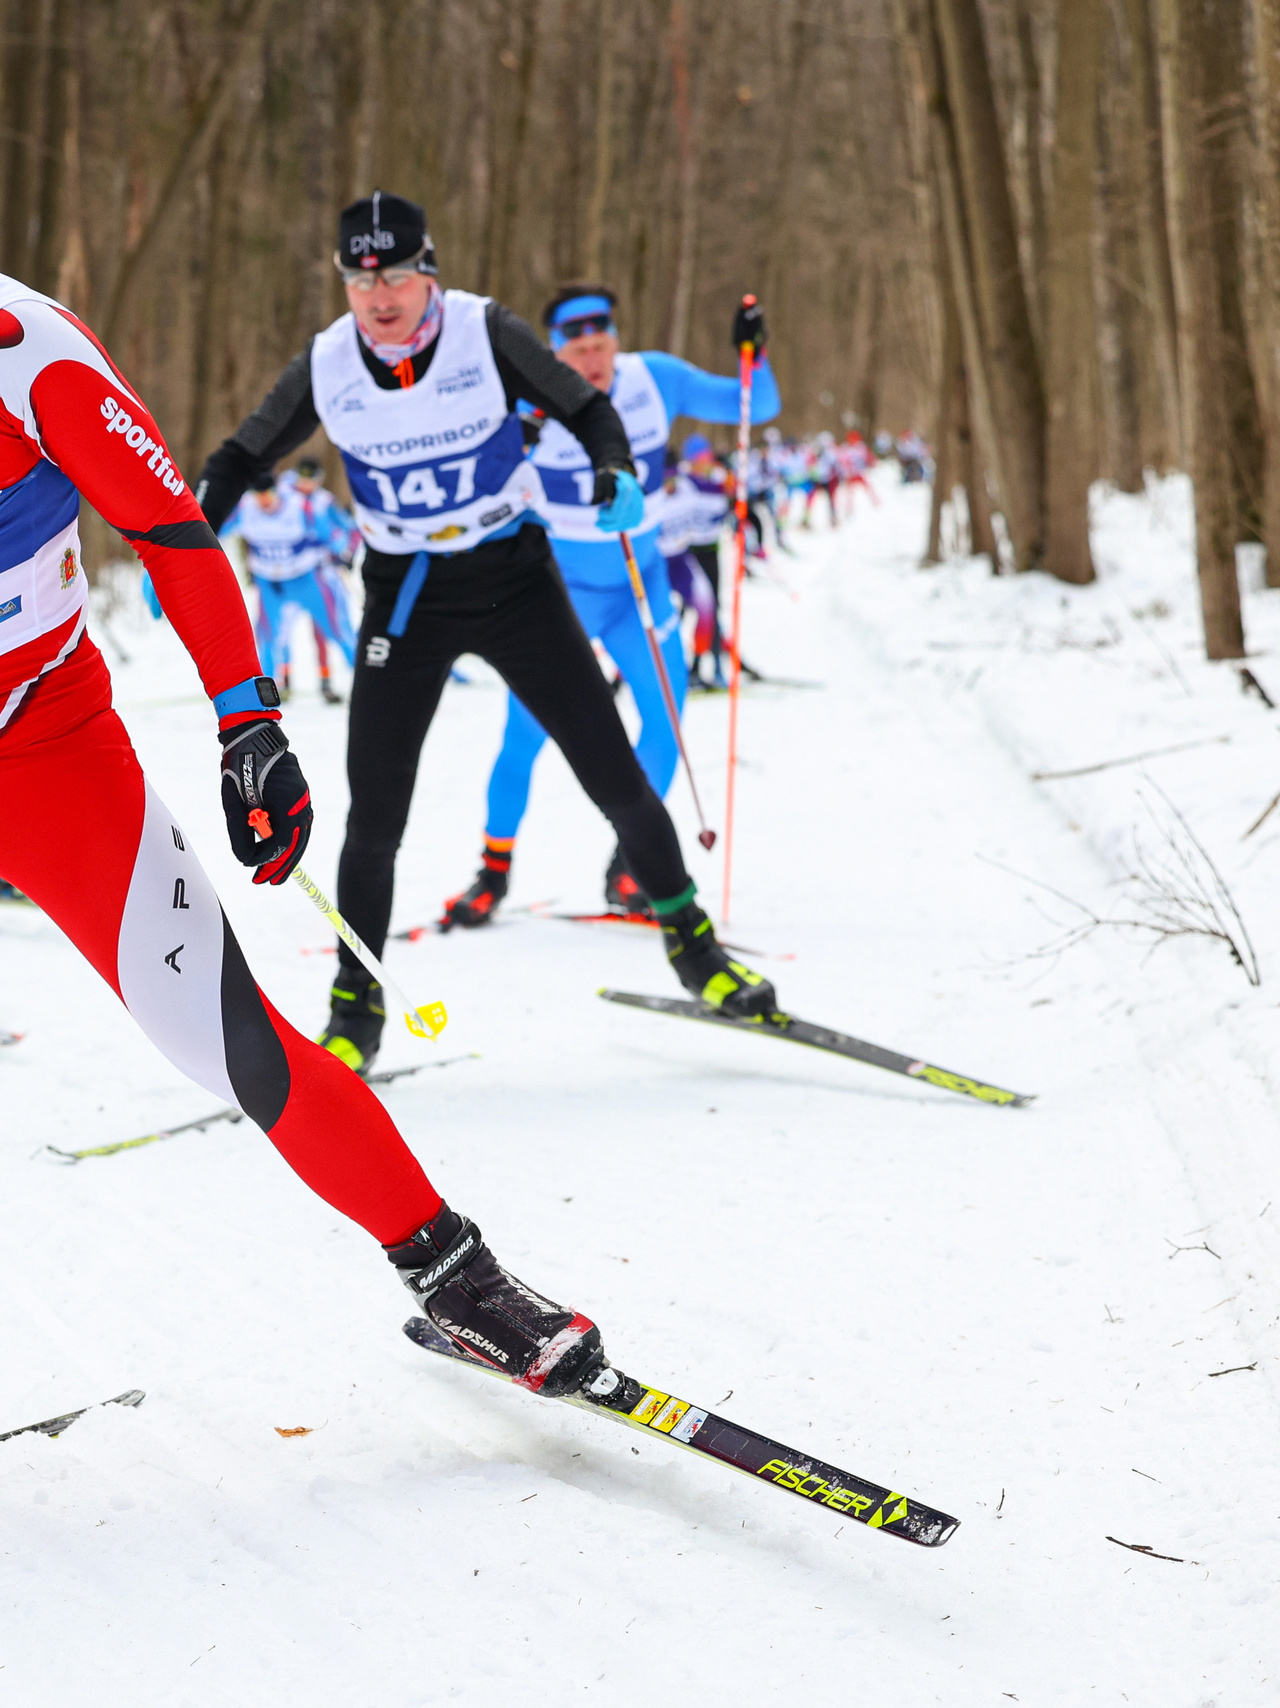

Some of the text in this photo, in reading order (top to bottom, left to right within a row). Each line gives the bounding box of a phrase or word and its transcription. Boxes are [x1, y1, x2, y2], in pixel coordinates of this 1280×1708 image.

[100, 396, 185, 497] sportful
[367, 454, 481, 514] 147
[419, 1235, 474, 1289] MADSHUS
[431, 1311, 510, 1364] MADSHUS
[756, 1458, 873, 1518] FISCHER
